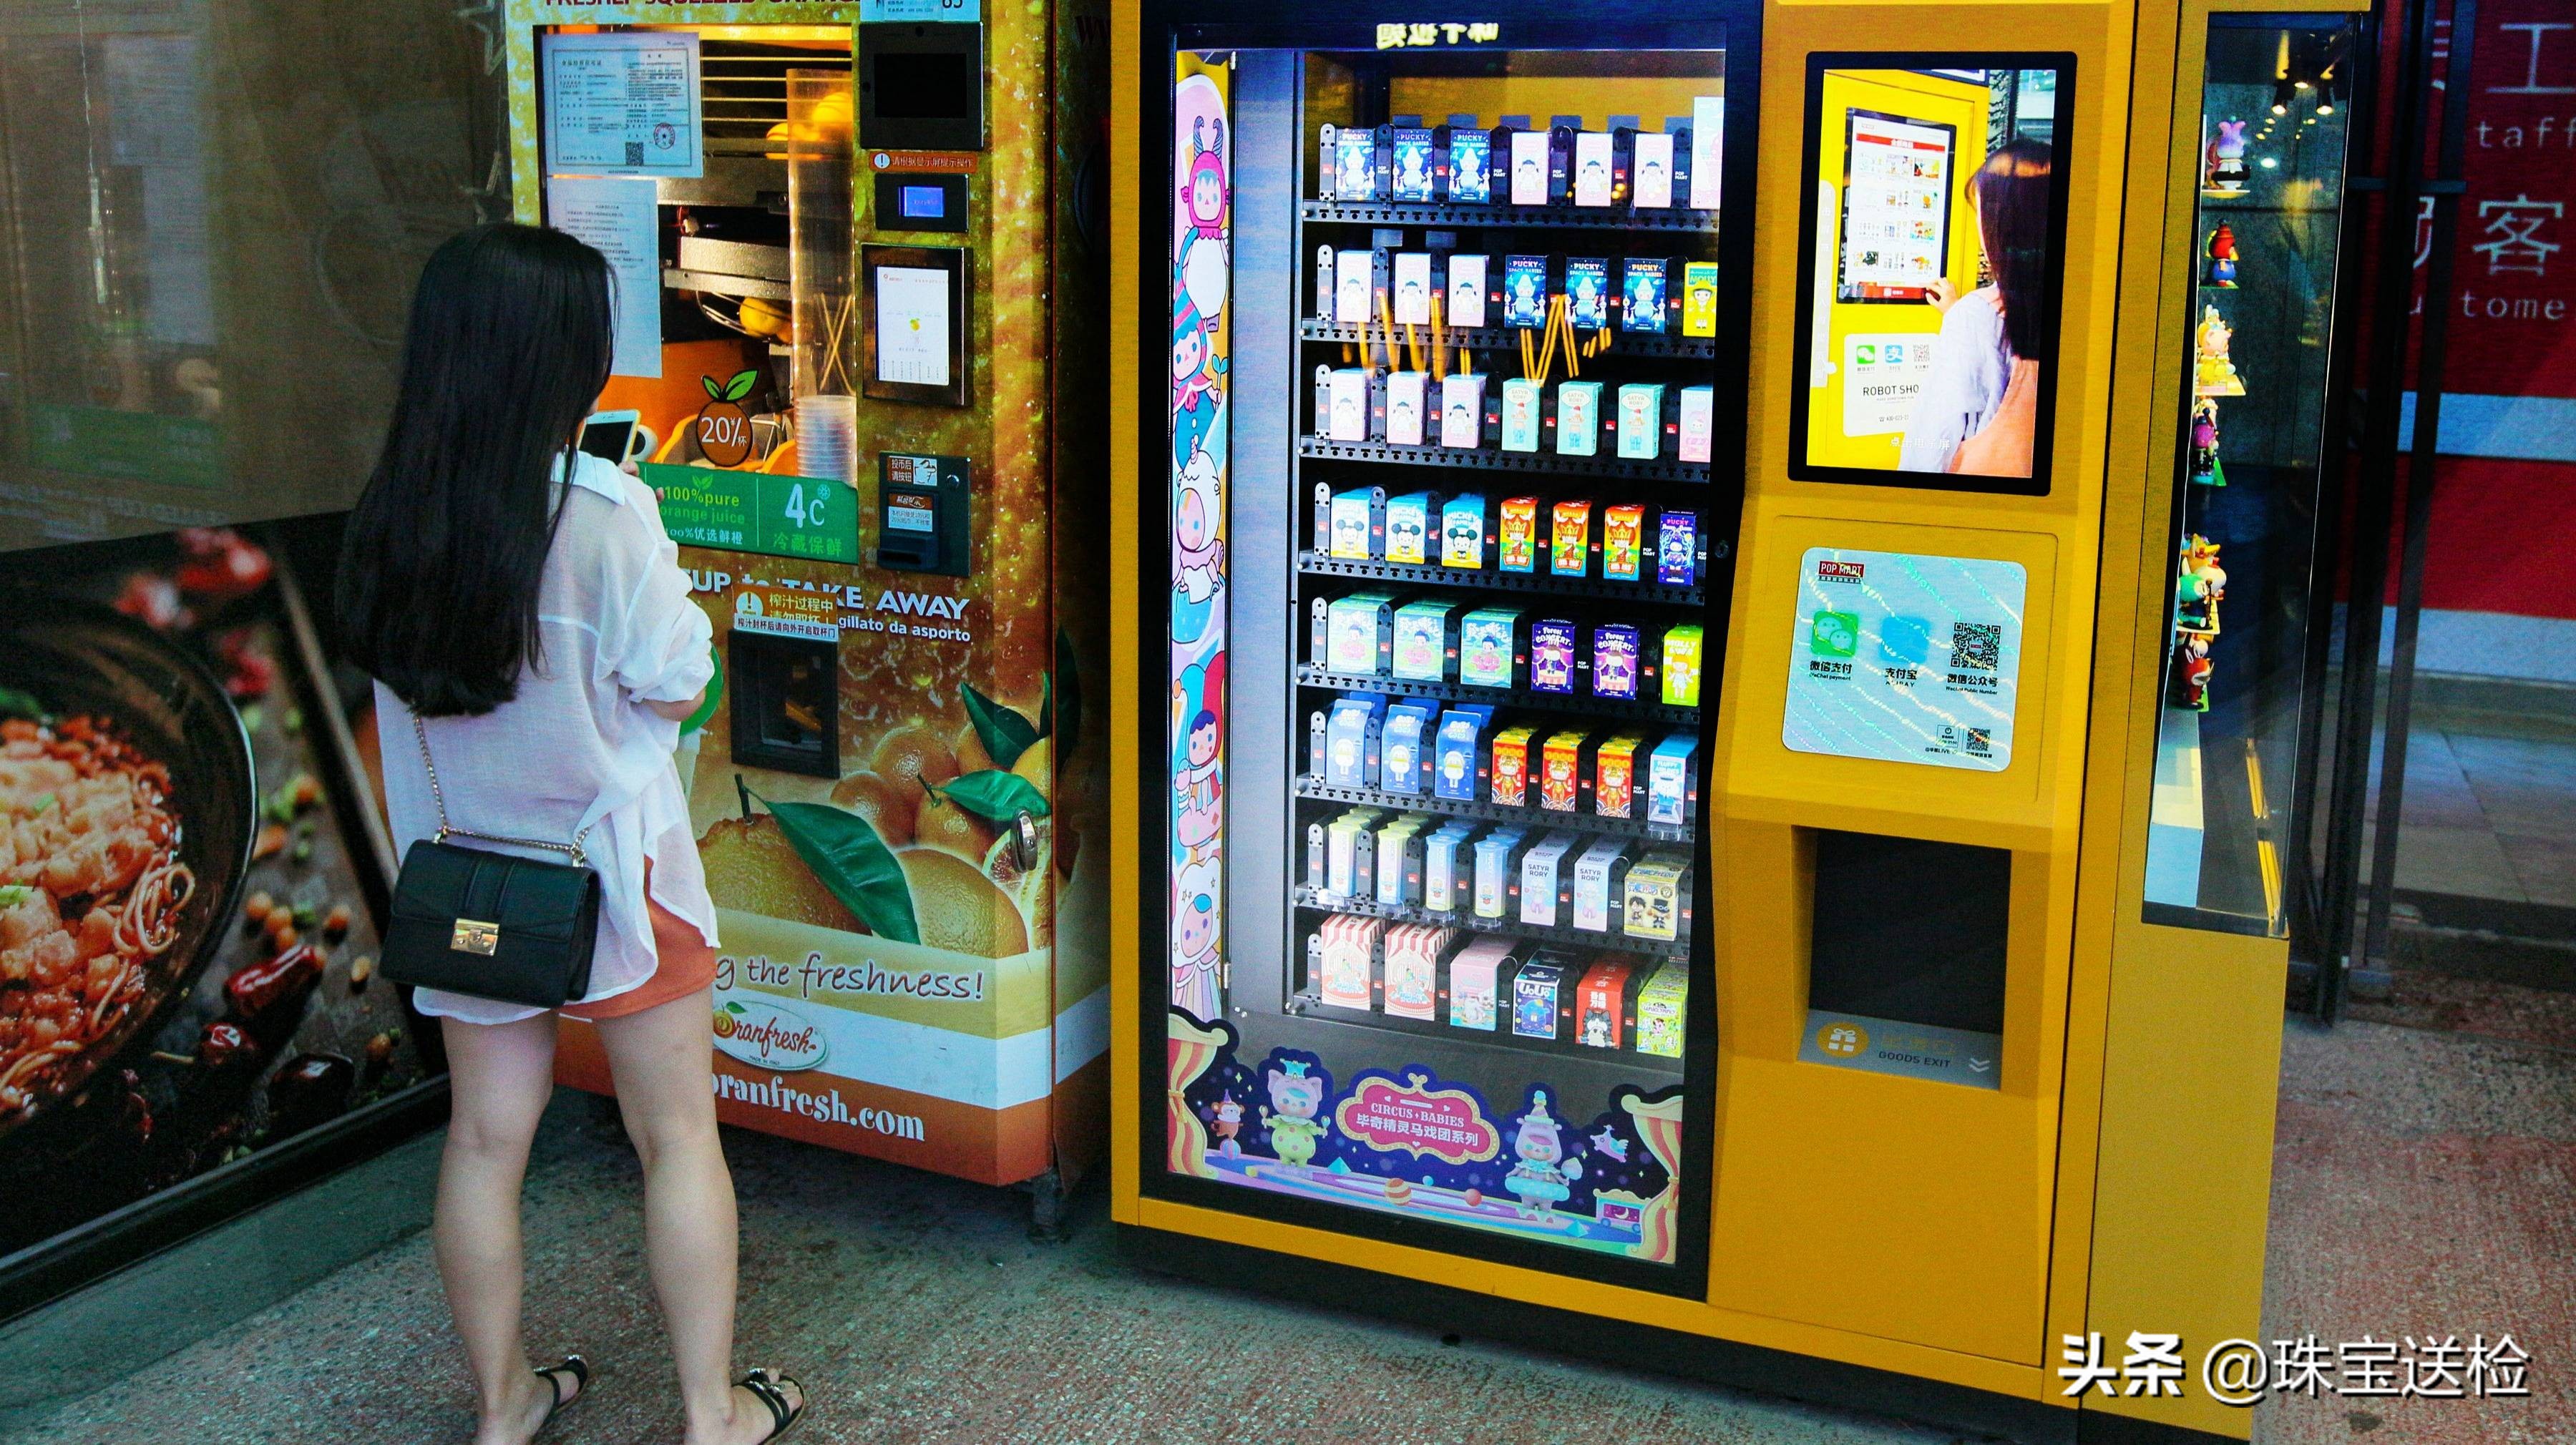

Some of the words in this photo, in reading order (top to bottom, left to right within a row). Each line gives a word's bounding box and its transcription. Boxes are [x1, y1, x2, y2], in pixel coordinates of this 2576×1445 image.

[1631, 263, 1659, 272] PUCKY
[1863, 385, 1896, 396] ROBOT
[892, 459, 912, 469] 投币后
[892, 471, 912, 482] 请按钮
[659, 505, 708, 522] orange
[711, 508, 745, 524] juice
[774, 532, 842, 557] 冷藏保鲜
[1820, 563, 1838, 574] POP
[1839, 564, 1862, 576] MART
[680, 569, 731, 593] UP
[876, 589, 970, 620] AWAY
[769, 592, 834, 613] 榨汁过程中
[889, 620, 907, 635] da
[912, 624, 971, 642] asporto
[1810, 660, 1853, 675] 微信支付
[1885, 667, 1918, 680] 支付宝
[1947, 673, 1998, 687] 微信公众号
[1528, 863, 1550, 873] SATYR
[1579, 868, 1601, 876] SATYR
[747, 956, 790, 986] the
[799, 952, 985, 1001] freshness!
[1878, 1051, 1921, 1064] GOODS
[1924, 1057, 1951, 1068] EXIT
[1371, 1102, 1413, 1119] CIRCUS
[1420, 1111, 1465, 1128] BABIES
[1357, 1112, 1479, 1147] 毕奇精灵马戏团系列
